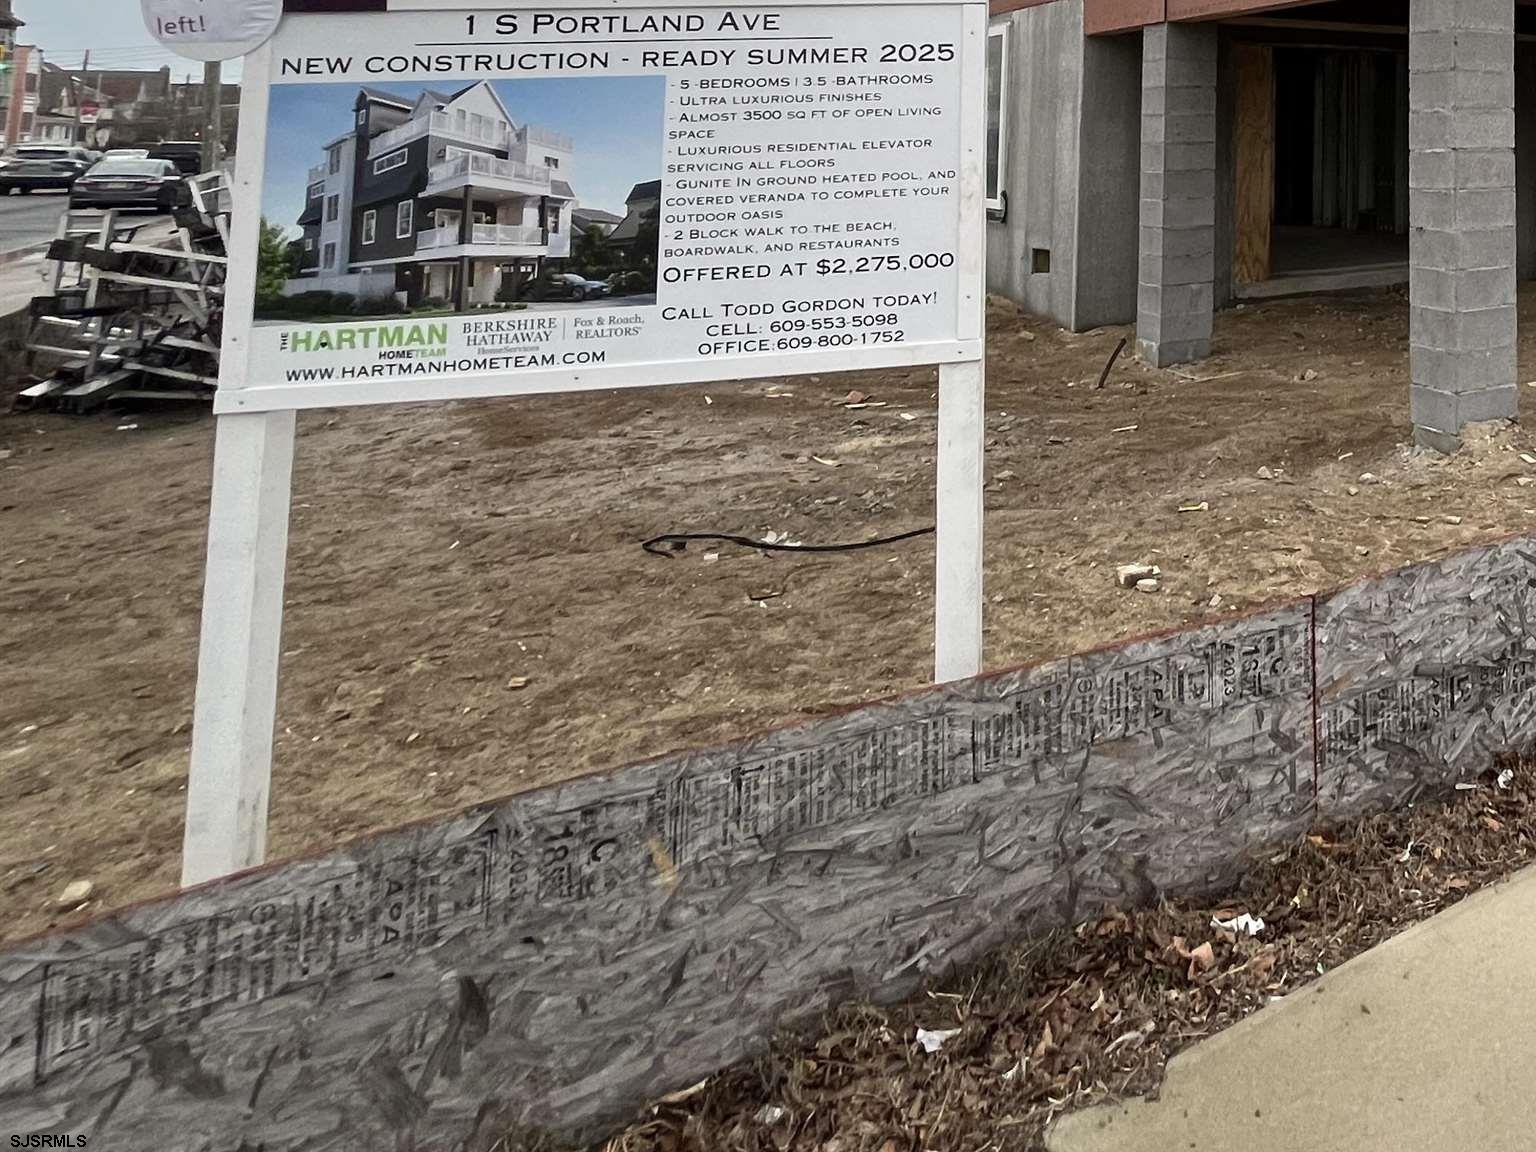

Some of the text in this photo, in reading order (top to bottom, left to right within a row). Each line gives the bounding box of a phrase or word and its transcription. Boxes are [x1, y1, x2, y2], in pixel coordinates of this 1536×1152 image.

[157, 13, 206, 36] left!
[466, 11, 780, 35] 1 S PORTLAND AVE
[281, 56, 353, 76] NEW
[365, 51, 608, 74] CONSTRUCTION
[642, 49, 736, 68] READY
[747, 46, 867, 66] SUMMER
[879, 43, 954, 63] 2025
[680, 79, 689, 89] 5
[680, 92, 882, 106] ULTRA LUXURIOUS FINISHES
[679, 107, 942, 123] ALMOST 3500 SQ FT OF OPEN LIVING
[668, 129, 716, 140] SPACE
[678, 139, 932, 156] LUXURIOUS RESIDENTIAL ELEVATOR
[667, 158, 835, 173] SERVICING ALL FLOORS
[675, 178, 732, 189] GUNITE
[736, 177, 751, 187] IN
[757, 175, 817, 186] GROUND
[822, 173, 877, 184] HEATED
[927, 170, 956, 180] AND
[665, 186, 949, 207] COVERED VERANDA TO COMPLETE YOUR
[665, 210, 784, 224] OUTDOOR OASIS
[673, 230, 683, 240] 2
[689, 229, 739, 240] BLOCK
[744, 227, 784, 236] WALK
[790, 225, 808, 234] TO
[813, 223, 840, 233] THE
[764, 242, 794, 253] AND
[799, 237, 900, 250] RESTAURANTS
[663, 264, 771, 283] OFFERED
[780, 262, 808, 277] AT
[662, 291, 937, 321] CALL TODD GORDON TODAY!
[463, 317, 557, 334] BERKSHIRE
[574, 317, 593, 327] Fox
[596, 316, 606, 326] &
[706, 313, 898, 337] CELL: 609-553-5098
[280, 332, 289, 351] THE
[291, 323, 448, 352] HARTMAN
[466, 331, 552, 346] HATHAWAY
[286, 351, 605, 382] WWW.HARTMANHOMETEAM.COM
